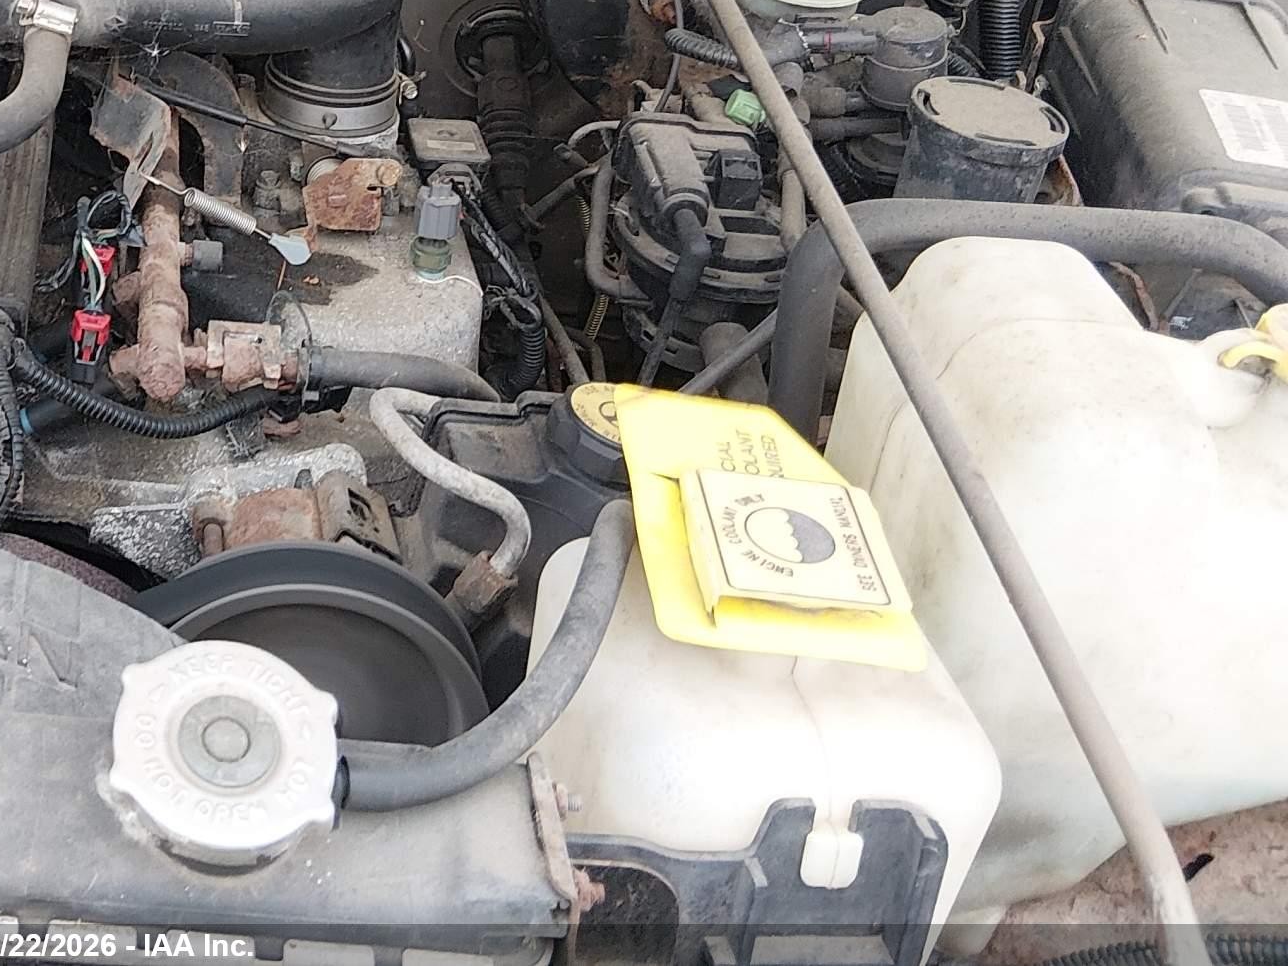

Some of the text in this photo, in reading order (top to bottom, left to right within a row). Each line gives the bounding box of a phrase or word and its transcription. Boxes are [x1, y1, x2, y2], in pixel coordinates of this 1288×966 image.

[717, 442, 736, 473] CIAL
[736, 430, 760, 476] OLANT
[722, 506, 742, 545] COOLANT
[741, 550, 794, 577] ENGINE
[856, 574, 877, 592] SEE
[169, 654, 311, 715] KEEP TIGHT
[133, 714, 157, 748] DO
[143, 757, 189, 807] NOT
[194, 799, 268, 824] OPEN
